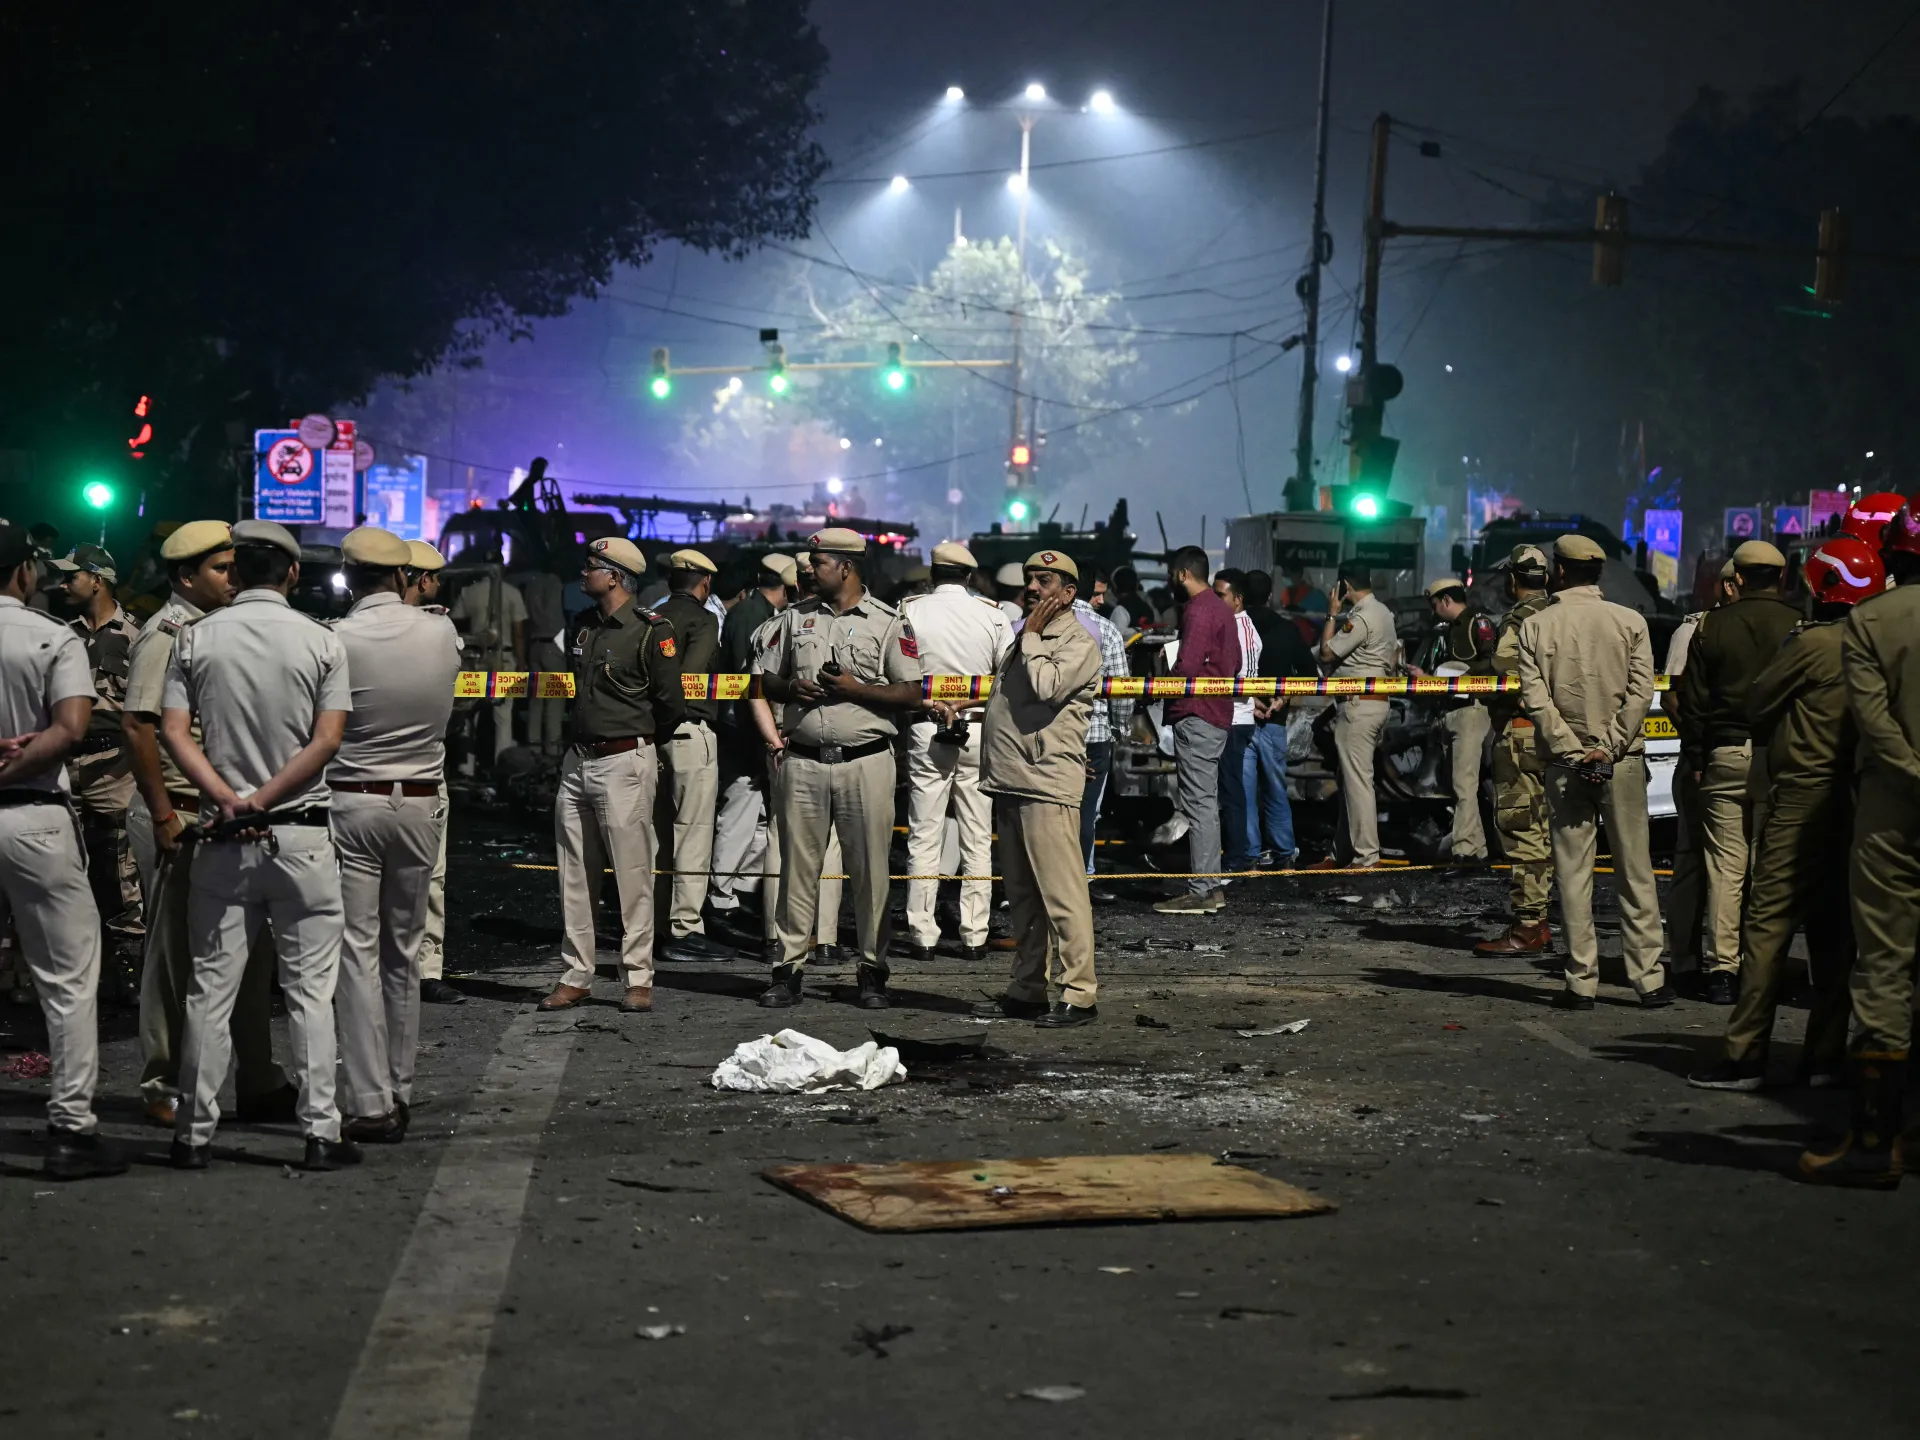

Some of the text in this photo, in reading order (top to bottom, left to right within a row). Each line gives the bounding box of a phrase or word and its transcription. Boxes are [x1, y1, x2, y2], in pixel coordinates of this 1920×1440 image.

[1155, 680, 1185, 688] POLICE
[1286, 680, 1316, 688] POLICE
[500, 686, 524, 694] DELHI
[1203, 686, 1230, 694] CROSS
